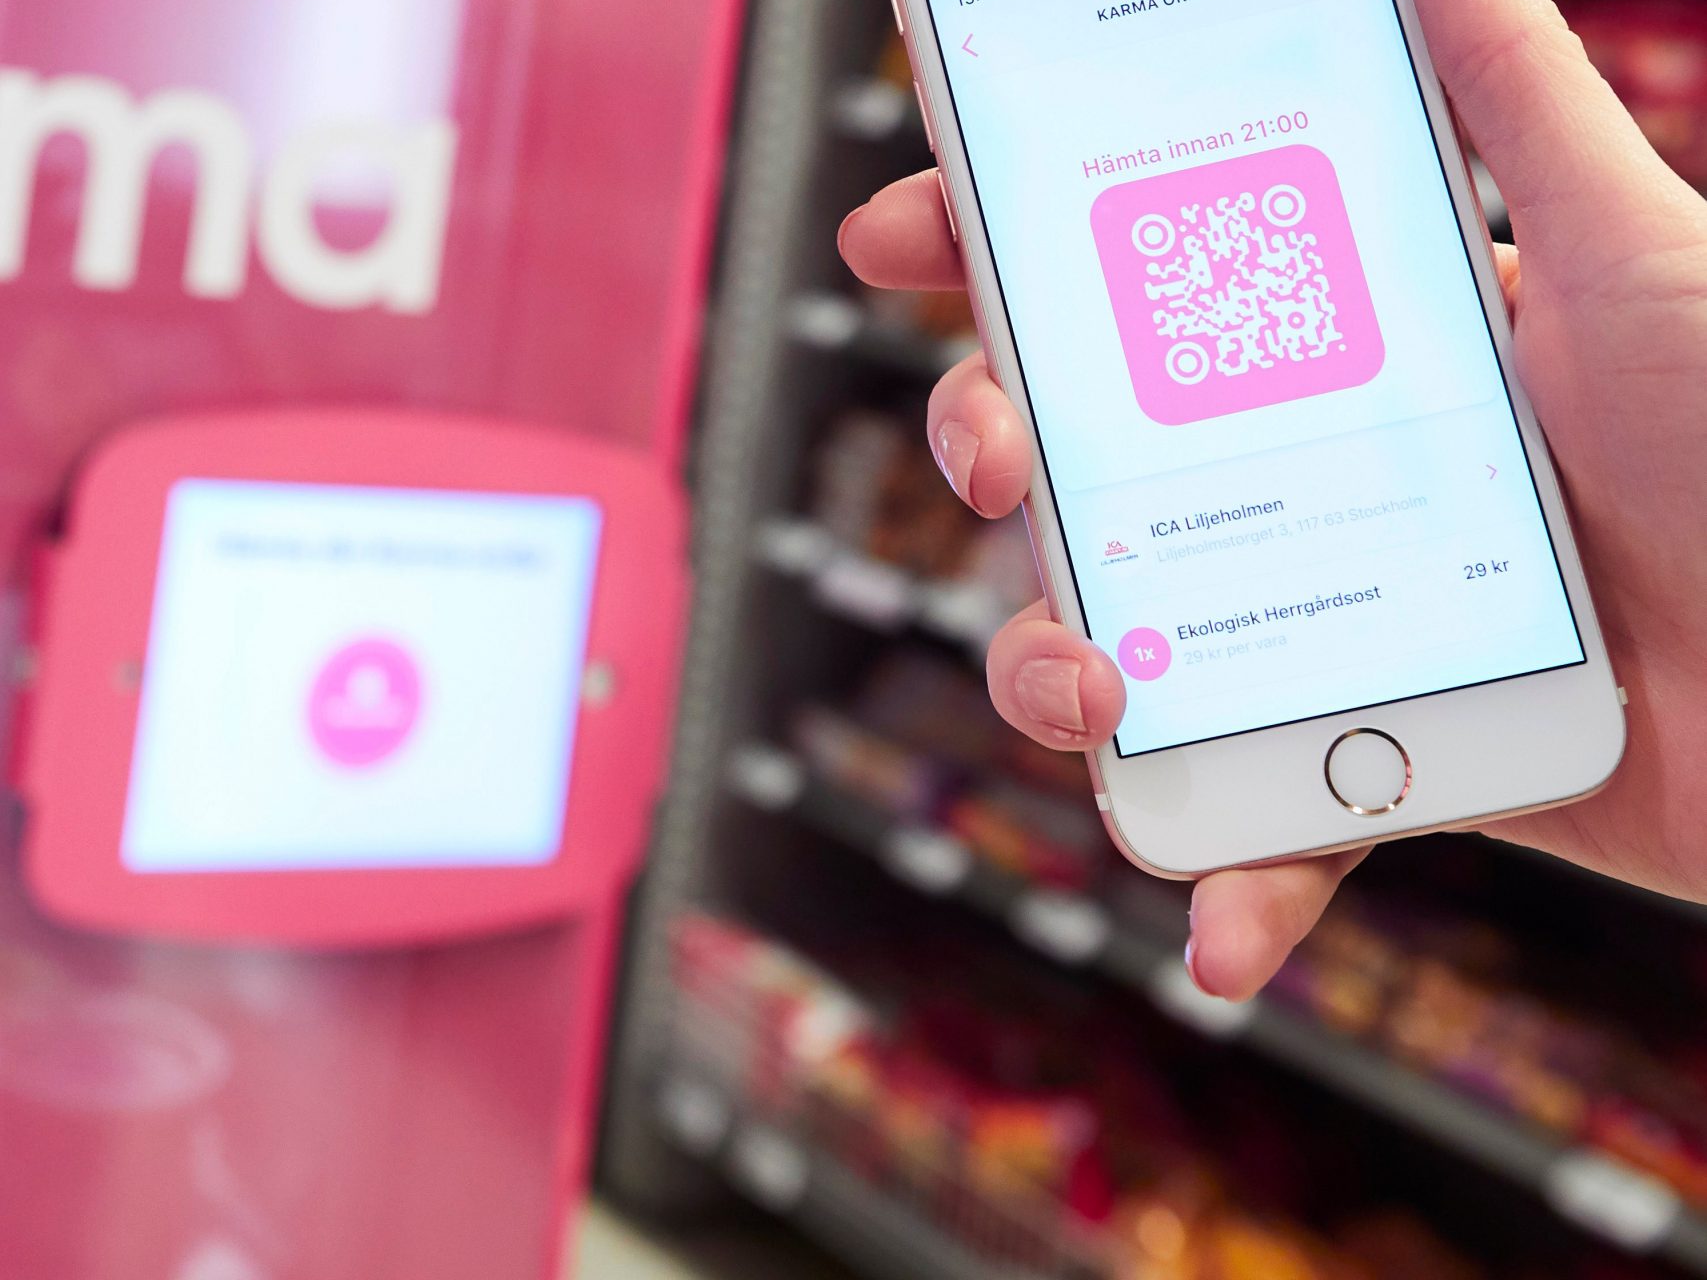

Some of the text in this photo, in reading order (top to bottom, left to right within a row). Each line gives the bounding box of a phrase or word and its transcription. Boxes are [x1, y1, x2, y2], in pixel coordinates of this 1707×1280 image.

[1082, 111, 1309, 178] Hämta innan 21:00
[1150, 500, 1284, 538] ICA Liljeholmen
[1156, 527, 1275, 563] Liljeholmstorget
[1297, 516, 1319, 532] 117
[1324, 511, 1345, 527] 63
[1348, 496, 1428, 521] Stockholm
[1464, 560, 1509, 580] 29 kr
[1177, 585, 1382, 640] Ekologisk Herrgårdsost
[1134, 646, 1156, 663] 1x
[1184, 633, 1288, 665] 29 kr per vara
